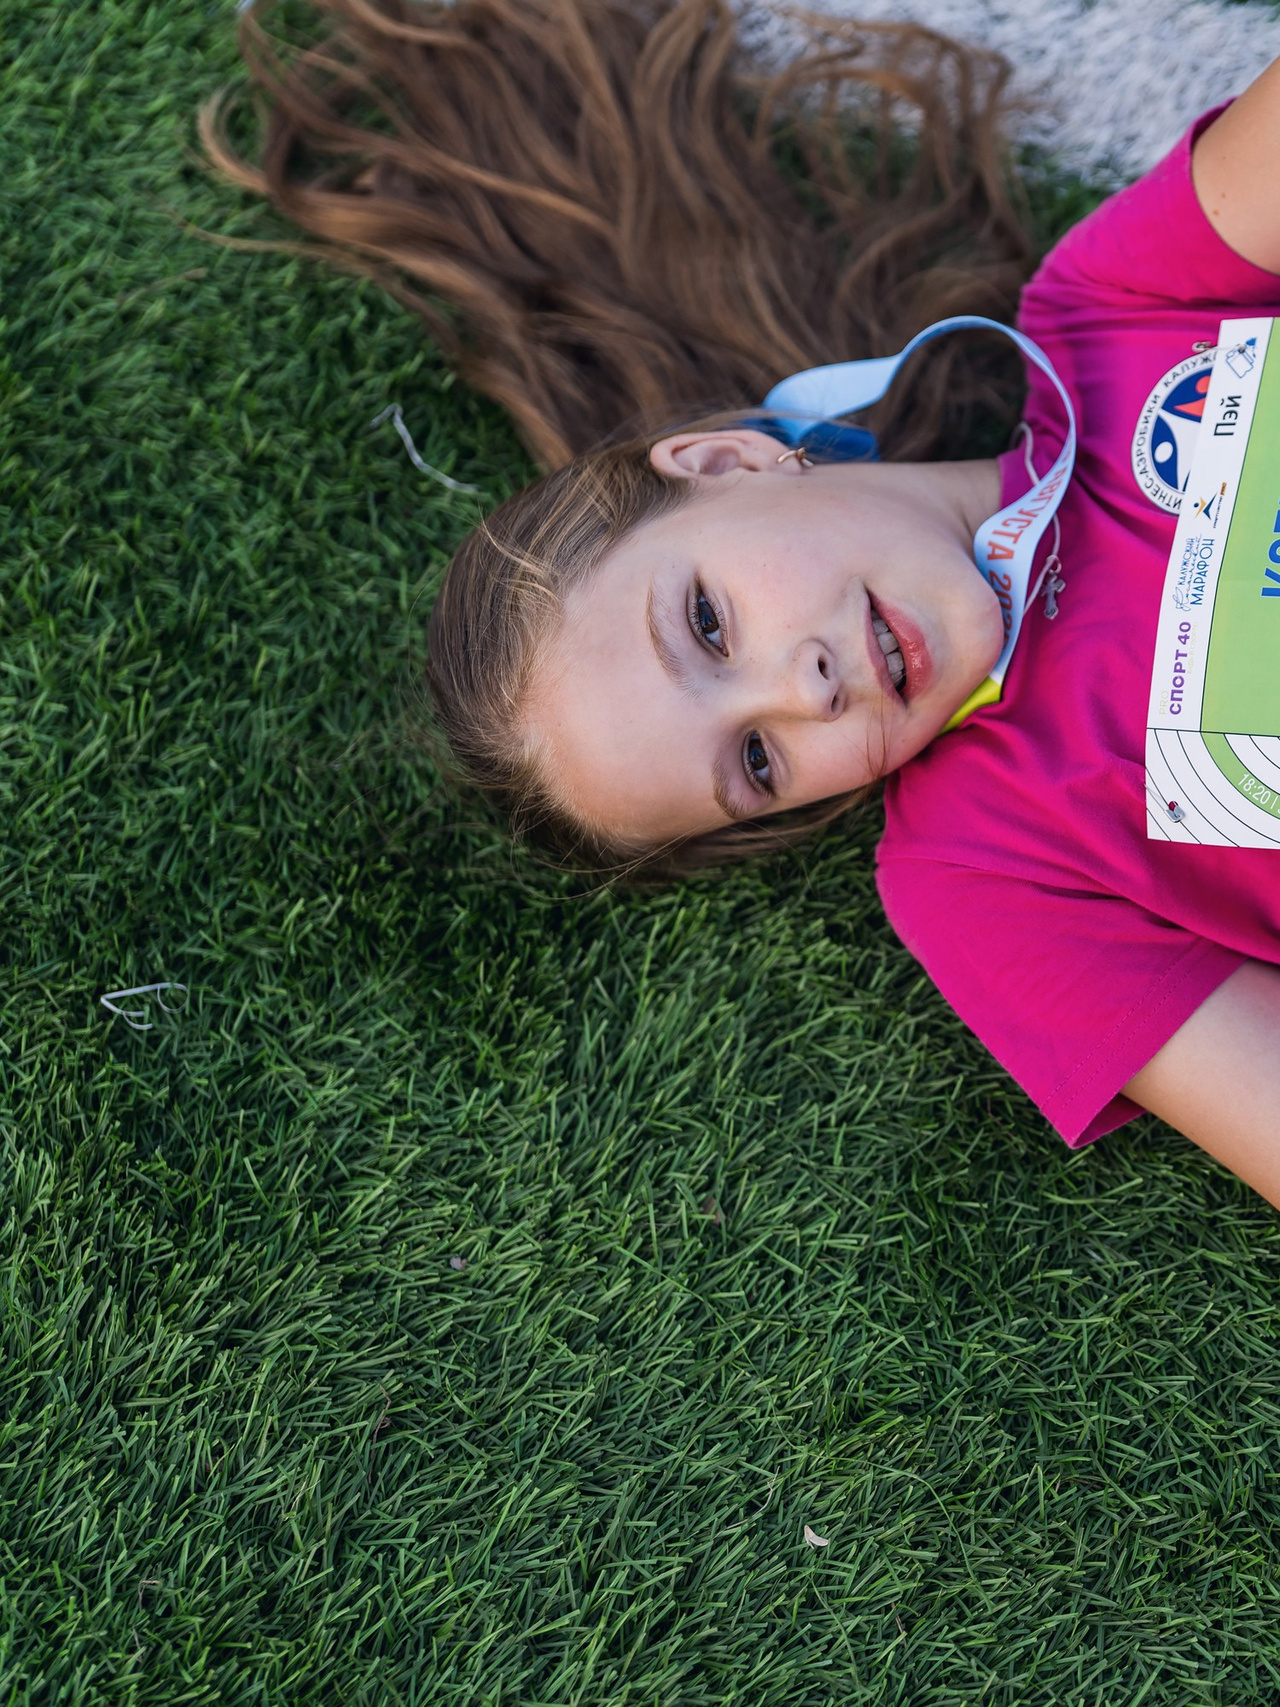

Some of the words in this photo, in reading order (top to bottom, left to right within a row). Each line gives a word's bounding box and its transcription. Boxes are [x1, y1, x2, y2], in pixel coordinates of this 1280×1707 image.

[1135, 395, 1182, 510] ИТНЕС-АЭРОБИКИ
[1163, 351, 1217, 388] КАЛУЖ
[1213, 395, 1242, 437] Пэй
[1178, 537, 1195, 585] КАЛУЖСКИЙ
[1190, 538, 1215, 606] МАРАФОН
[989, 569, 1013, 647] 20
[1177, 621, 1192, 645] 40
[1169, 649, 1187, 715] СПОРТ
[1238, 773, 1271, 805] 18:20
